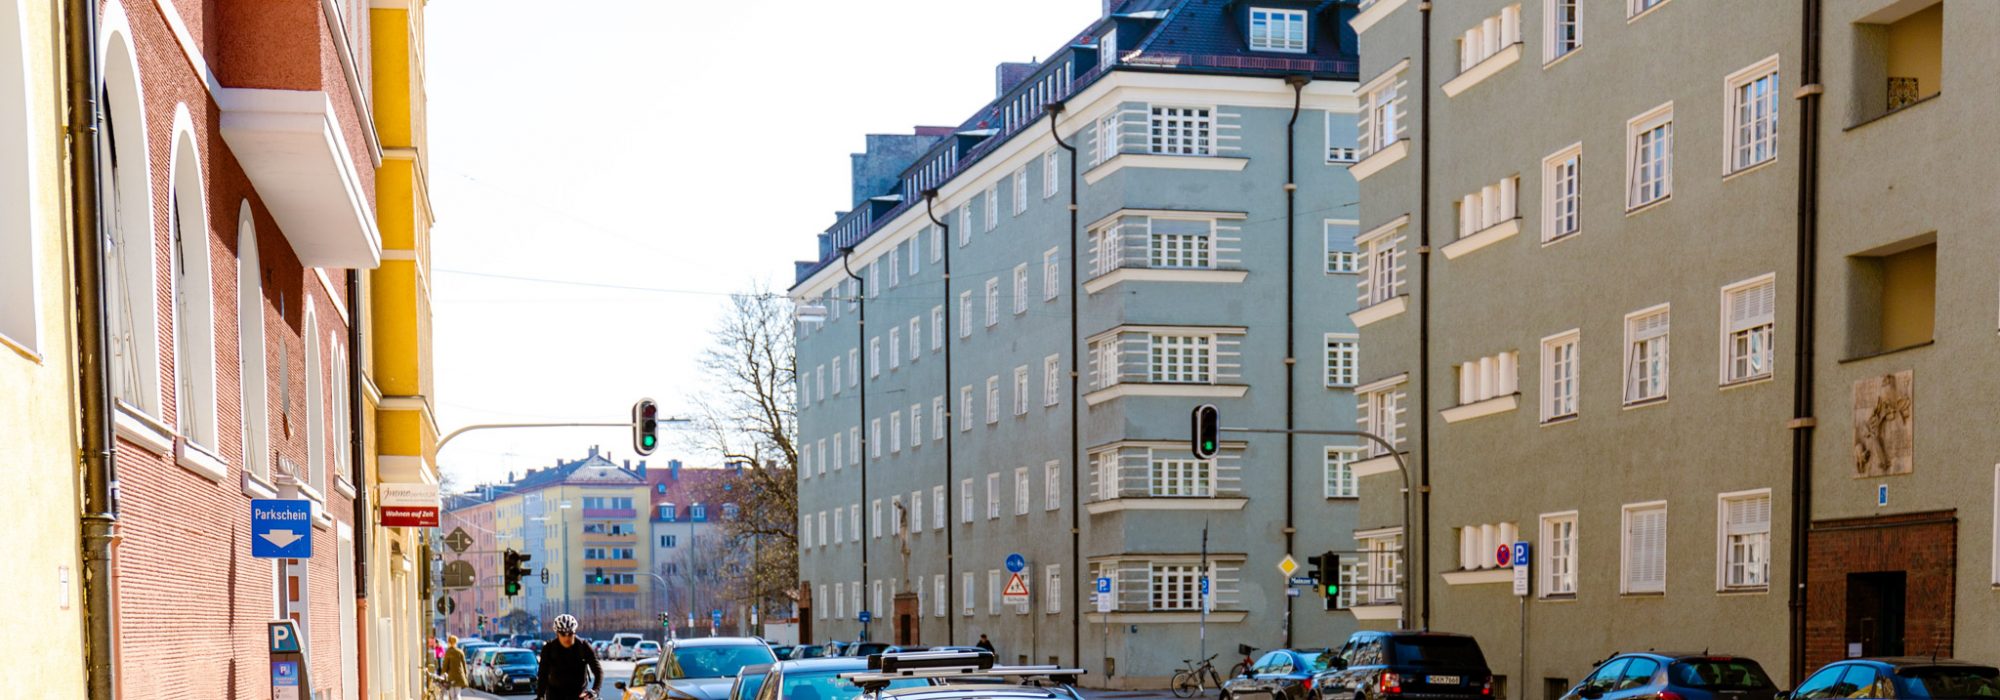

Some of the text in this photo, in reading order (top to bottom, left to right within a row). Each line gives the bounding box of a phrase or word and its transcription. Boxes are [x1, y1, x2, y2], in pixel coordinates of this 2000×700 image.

[255, 508, 307, 520] Parkschein
[422, 510, 434, 518] Zeit
[1516, 545, 1524, 563] P
[1099, 579, 1107, 591] P
[273, 626, 289, 649] P
